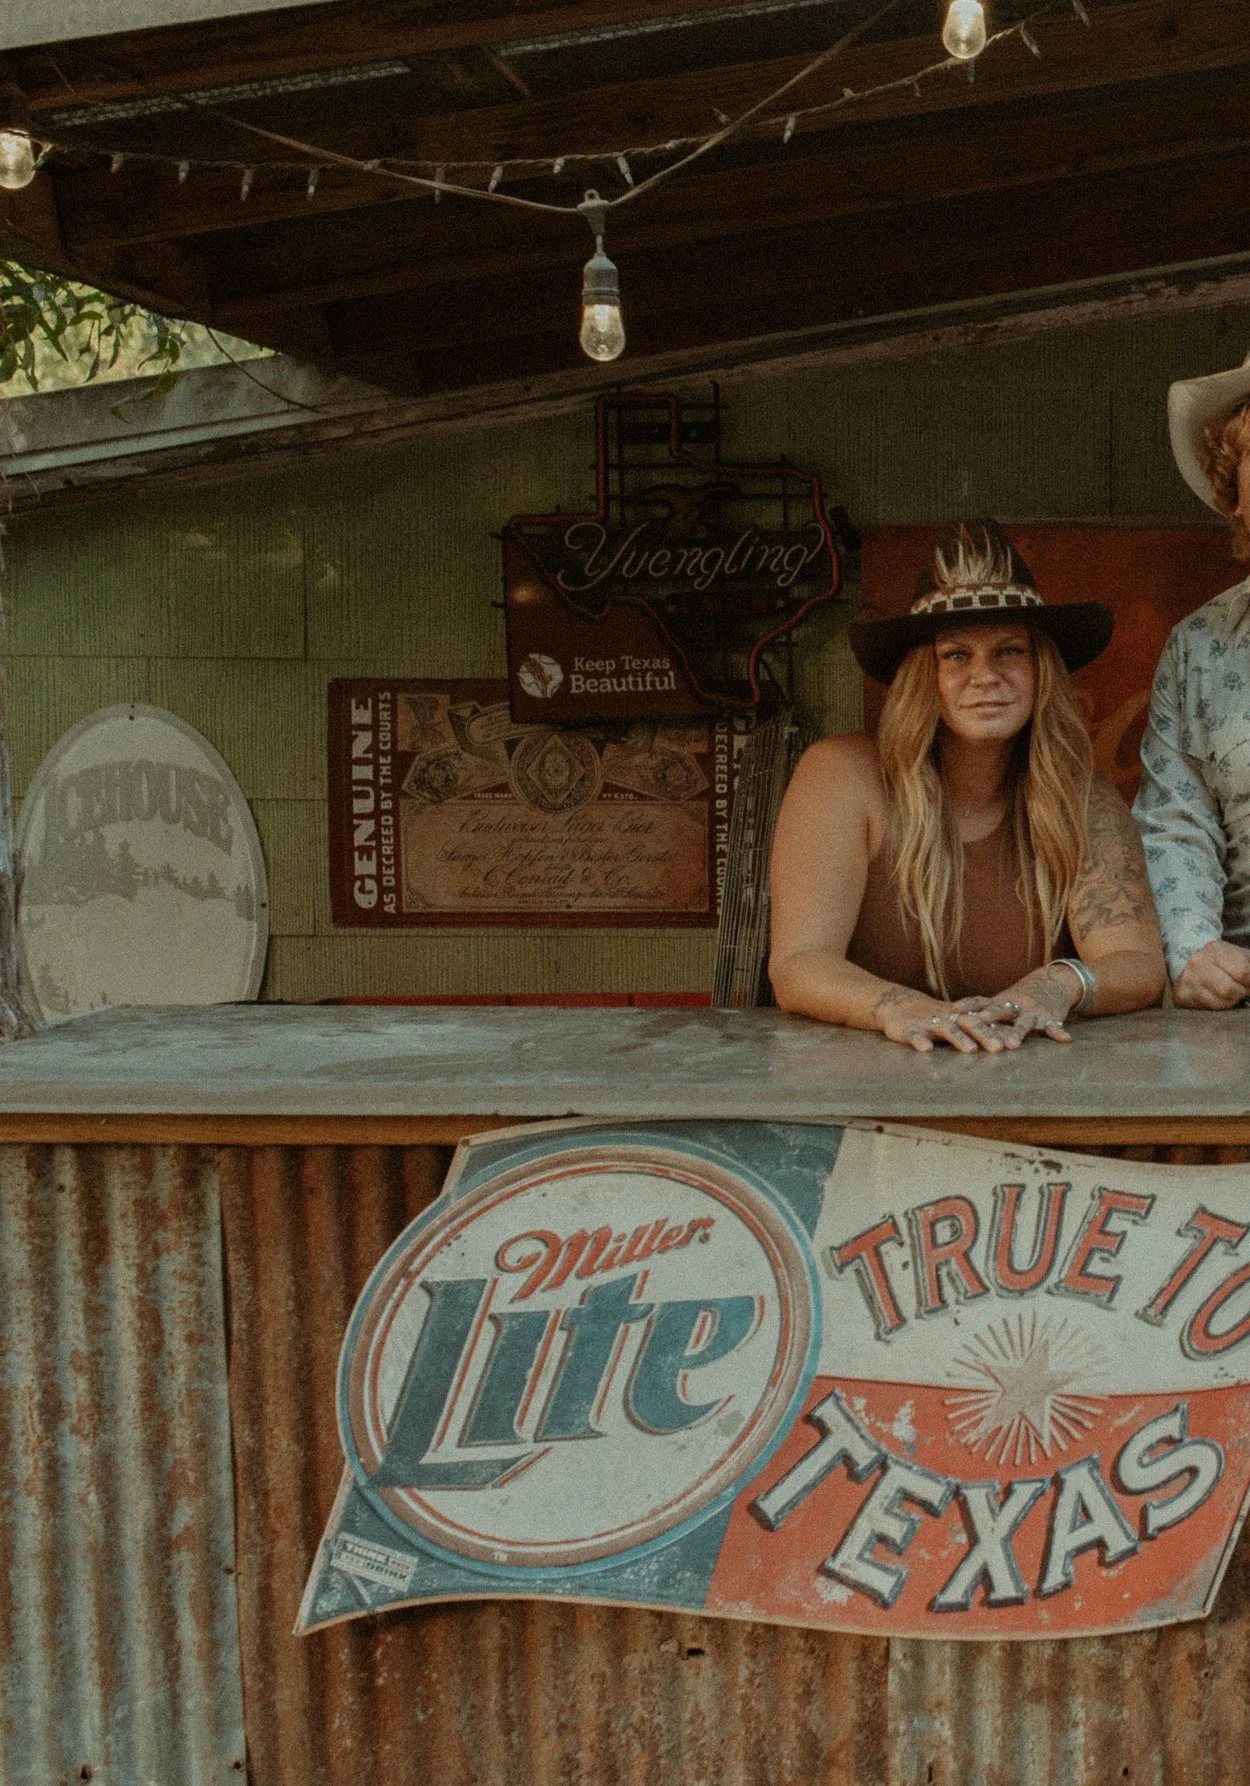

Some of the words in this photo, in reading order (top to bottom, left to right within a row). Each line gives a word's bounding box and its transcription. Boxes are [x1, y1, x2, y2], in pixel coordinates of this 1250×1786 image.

[557, 521, 825, 592] Yuengling
[570, 671, 677, 695] Beautiful
[573, 656, 616, 676] Keep
[619, 654, 671, 672] Texas
[377, 691, 392, 750] COURTS
[351, 696, 378, 910] GENUINE
[378, 755, 392, 786] THE
[379, 789, 393, 810] BY
[714, 798, 730, 818] BY
[380, 815, 396, 887] DECREED
[382, 893, 397, 914] AS
[495, 1216, 716, 1303] Miller
[829, 1182, 1156, 1341] TRUE
[366, 1270, 766, 1490] Lite
[748, 1388, 1226, 1613] TEXAS
